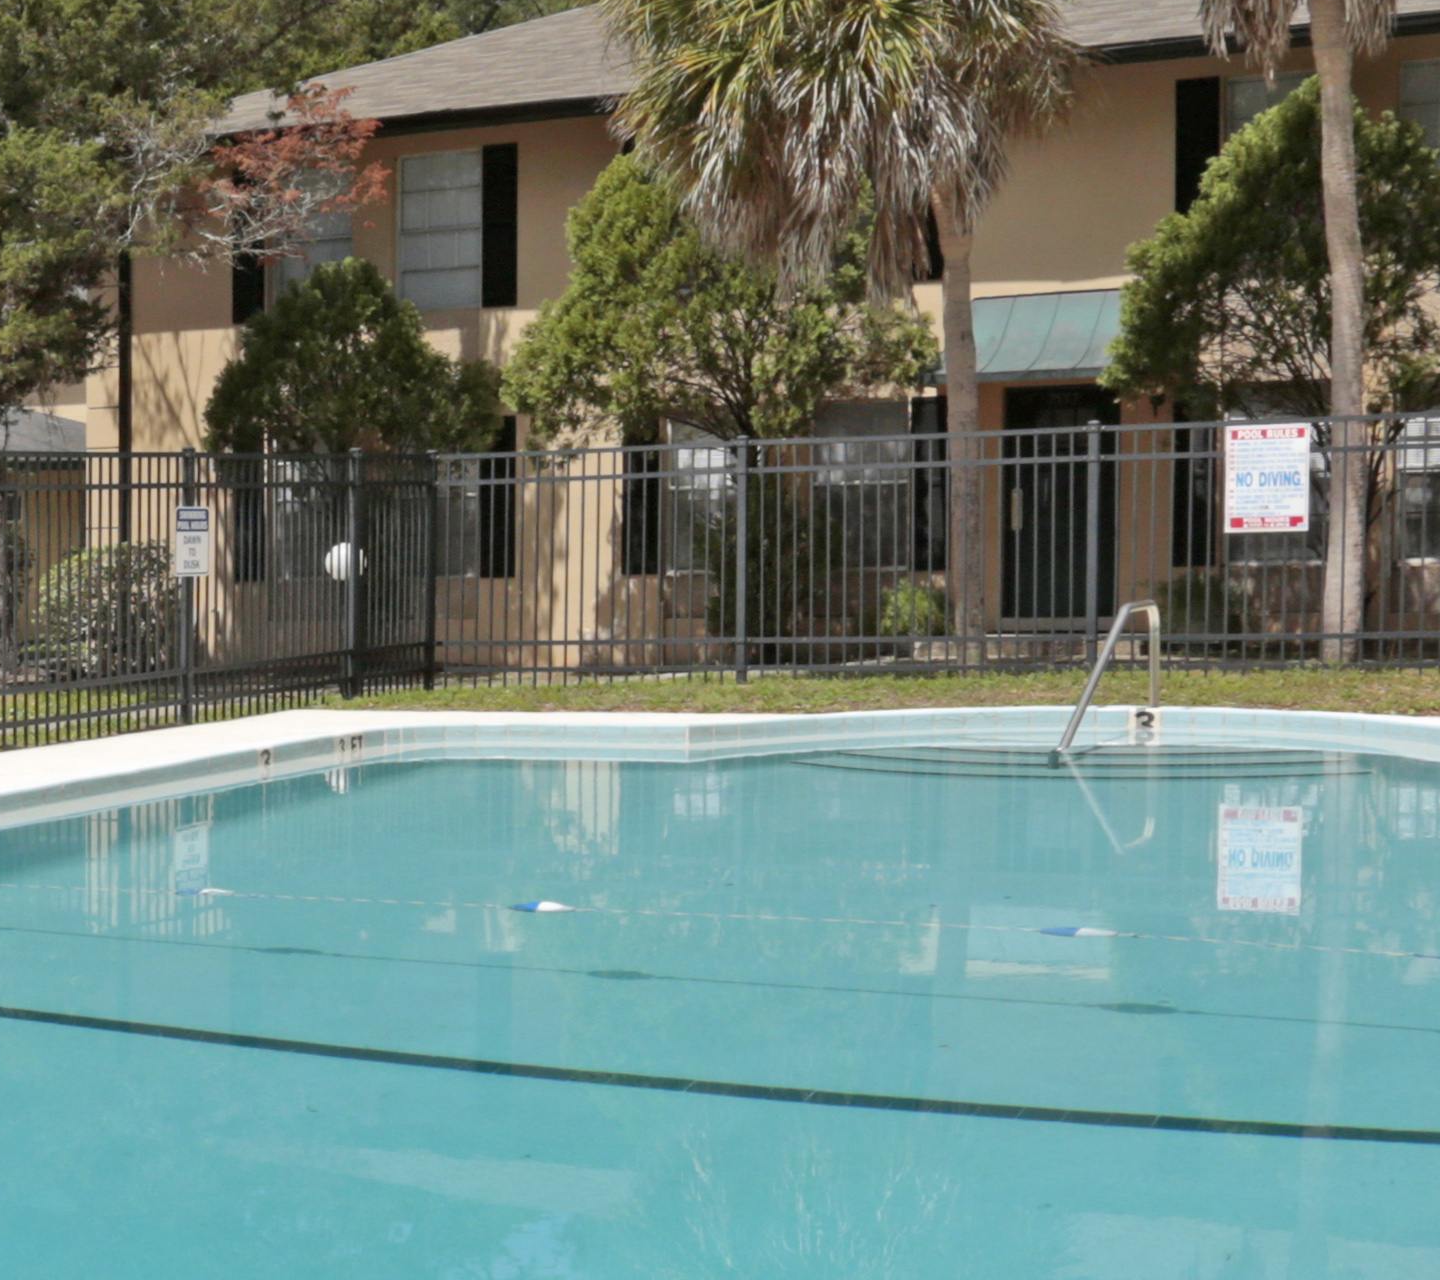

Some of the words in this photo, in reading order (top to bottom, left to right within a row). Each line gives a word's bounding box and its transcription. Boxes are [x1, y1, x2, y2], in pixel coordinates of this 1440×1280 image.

[1238, 430, 1264, 440] POOL
[1236, 472, 1253, 488] NO
[183, 535, 201, 544] DAWN
[188, 547, 197, 556] TO
[183, 560, 200, 569] DUSK
